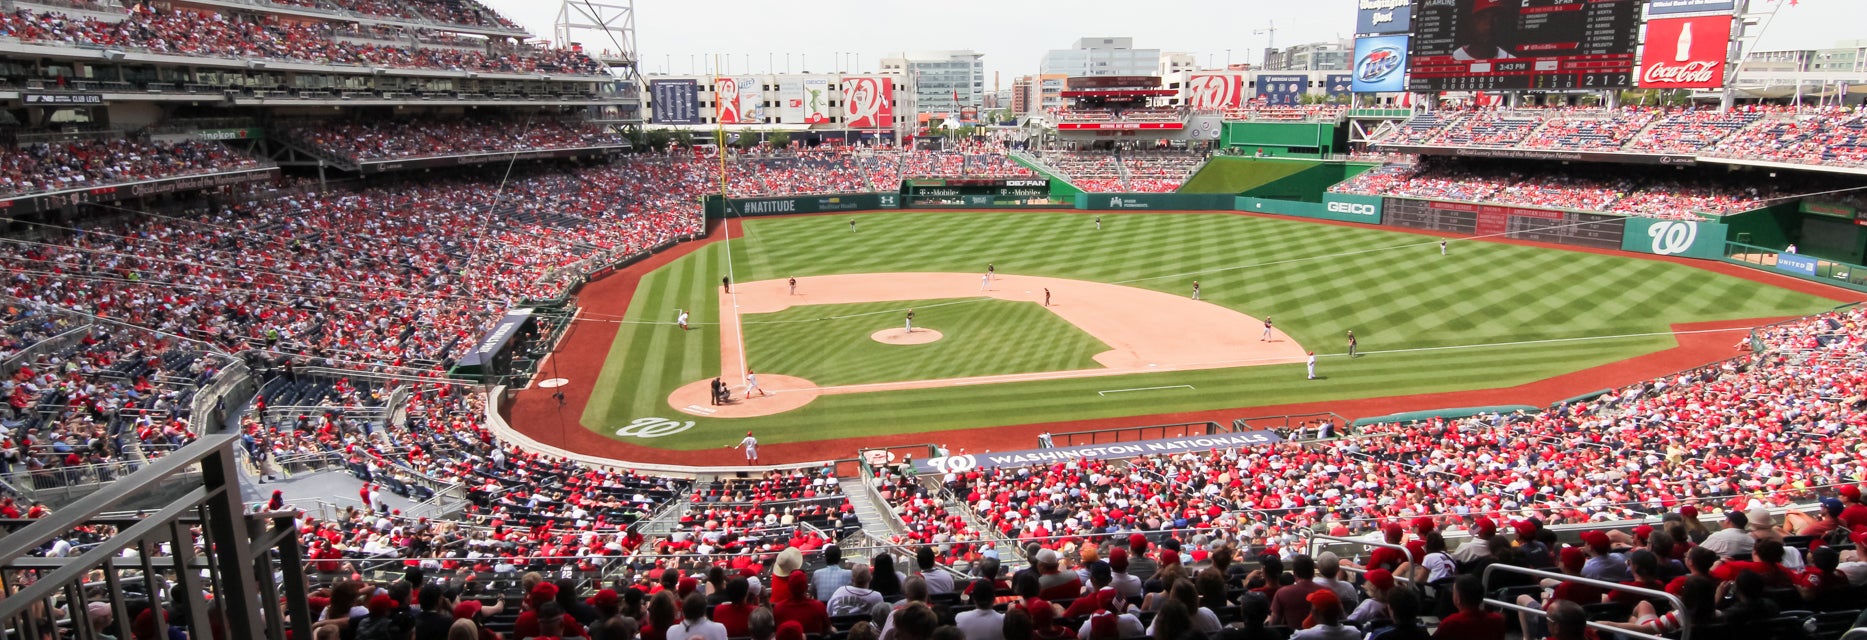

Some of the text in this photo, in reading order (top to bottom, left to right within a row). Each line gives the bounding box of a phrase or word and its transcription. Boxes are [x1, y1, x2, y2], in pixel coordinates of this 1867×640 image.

[1644, 61, 1719, 83] Coca-Cola
[1586, 75, 1625, 85] 2 1 2
[131, 184, 154, 197] Official
[156, 182, 175, 194] Luxury
[176, 180, 196, 190] Vehicle
[83, 193, 88, 202] 2
[744, 200, 795, 213] #NATITUDE
[1327, 201, 1375, 215] GEICO
[1647, 221, 1697, 255] W
[1778, 258, 1805, 269] UNITED
[988, 443, 1144, 466] WASHINGTON
[1147, 433, 1270, 453] NATIONALS
[562, 571, 572, 579] 22
